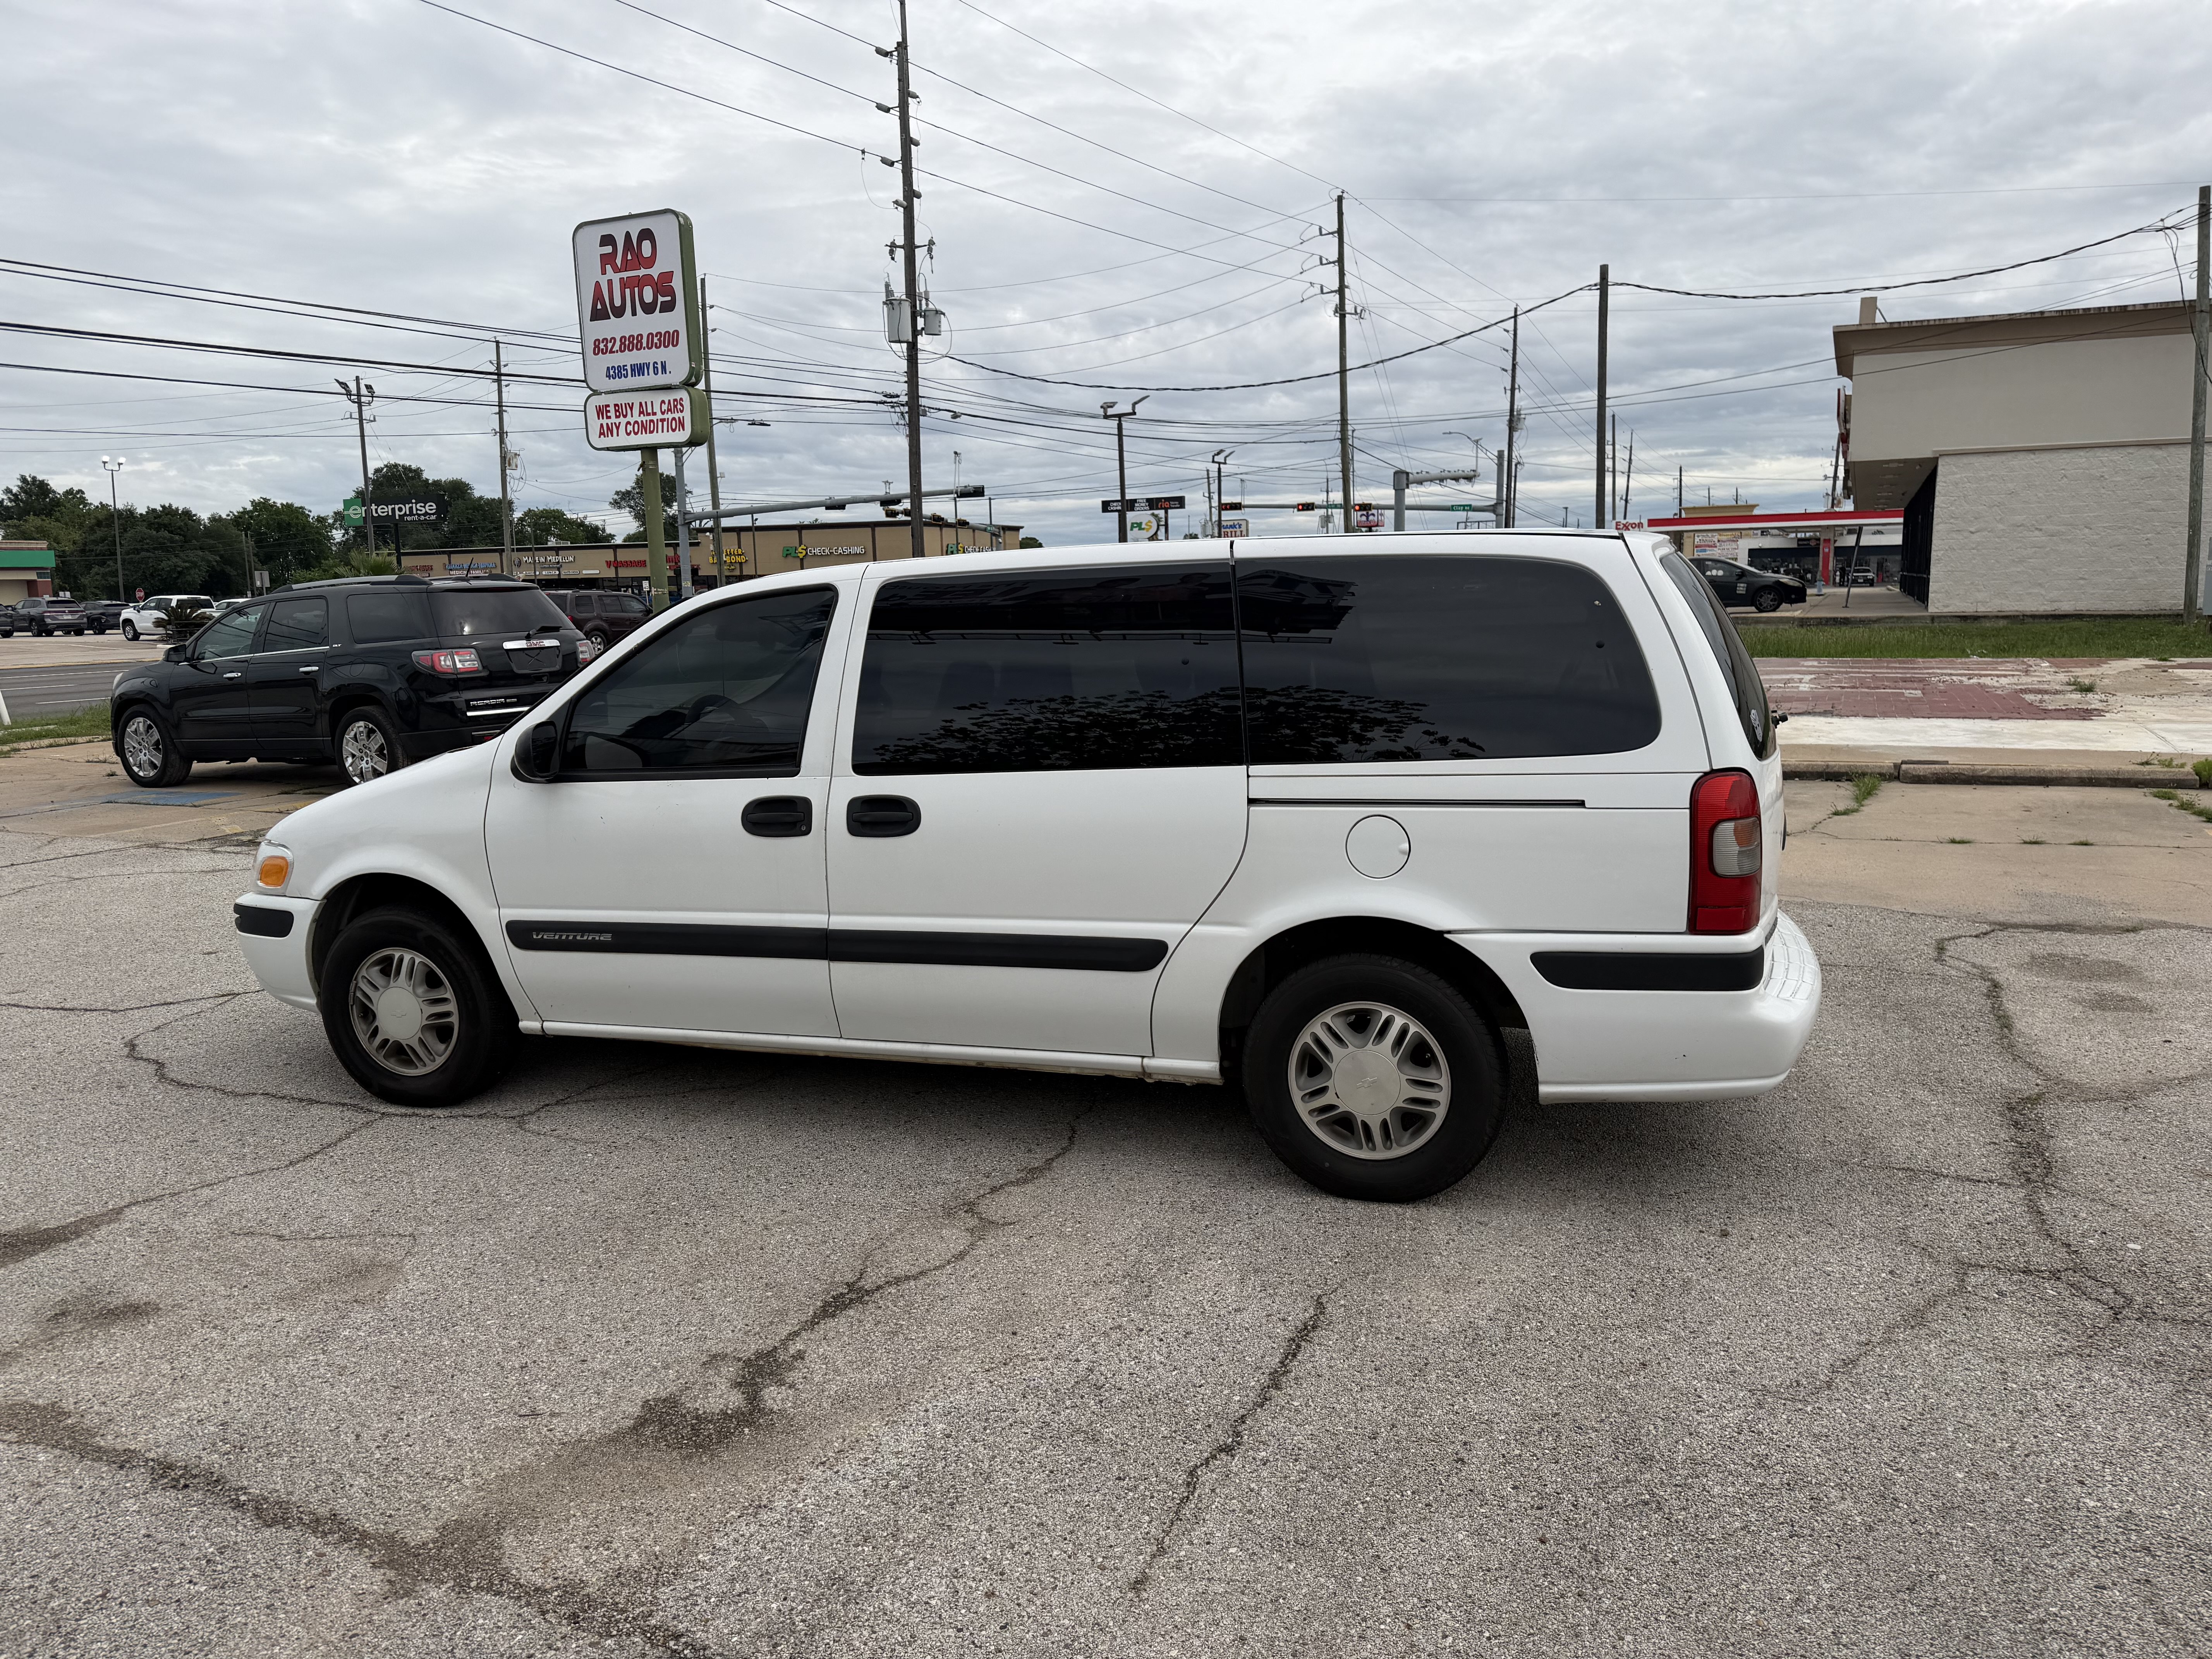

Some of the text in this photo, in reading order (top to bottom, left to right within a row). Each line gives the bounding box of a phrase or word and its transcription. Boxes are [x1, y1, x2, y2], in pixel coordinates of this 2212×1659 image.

[599, 228, 657, 275] RAO
[589, 271, 677, 322] AUTOS
[592, 329, 680, 356] 832.888.0300
[605, 364, 629, 380] 4385
[630, 362, 651, 378] HWY
[653, 362, 659, 376] 6
[595, 397, 684, 420] WE BUY ALL CARS
[598, 416, 685, 438] ANY CONDITION
[1158, 499, 1170, 508] ria
[1615, 521, 1644, 531] Exxon
[833, 546, 865, 555] CASHING
[613, 560, 647, 568] MASSAGE
[532, 932, 613, 941] VENTURE
